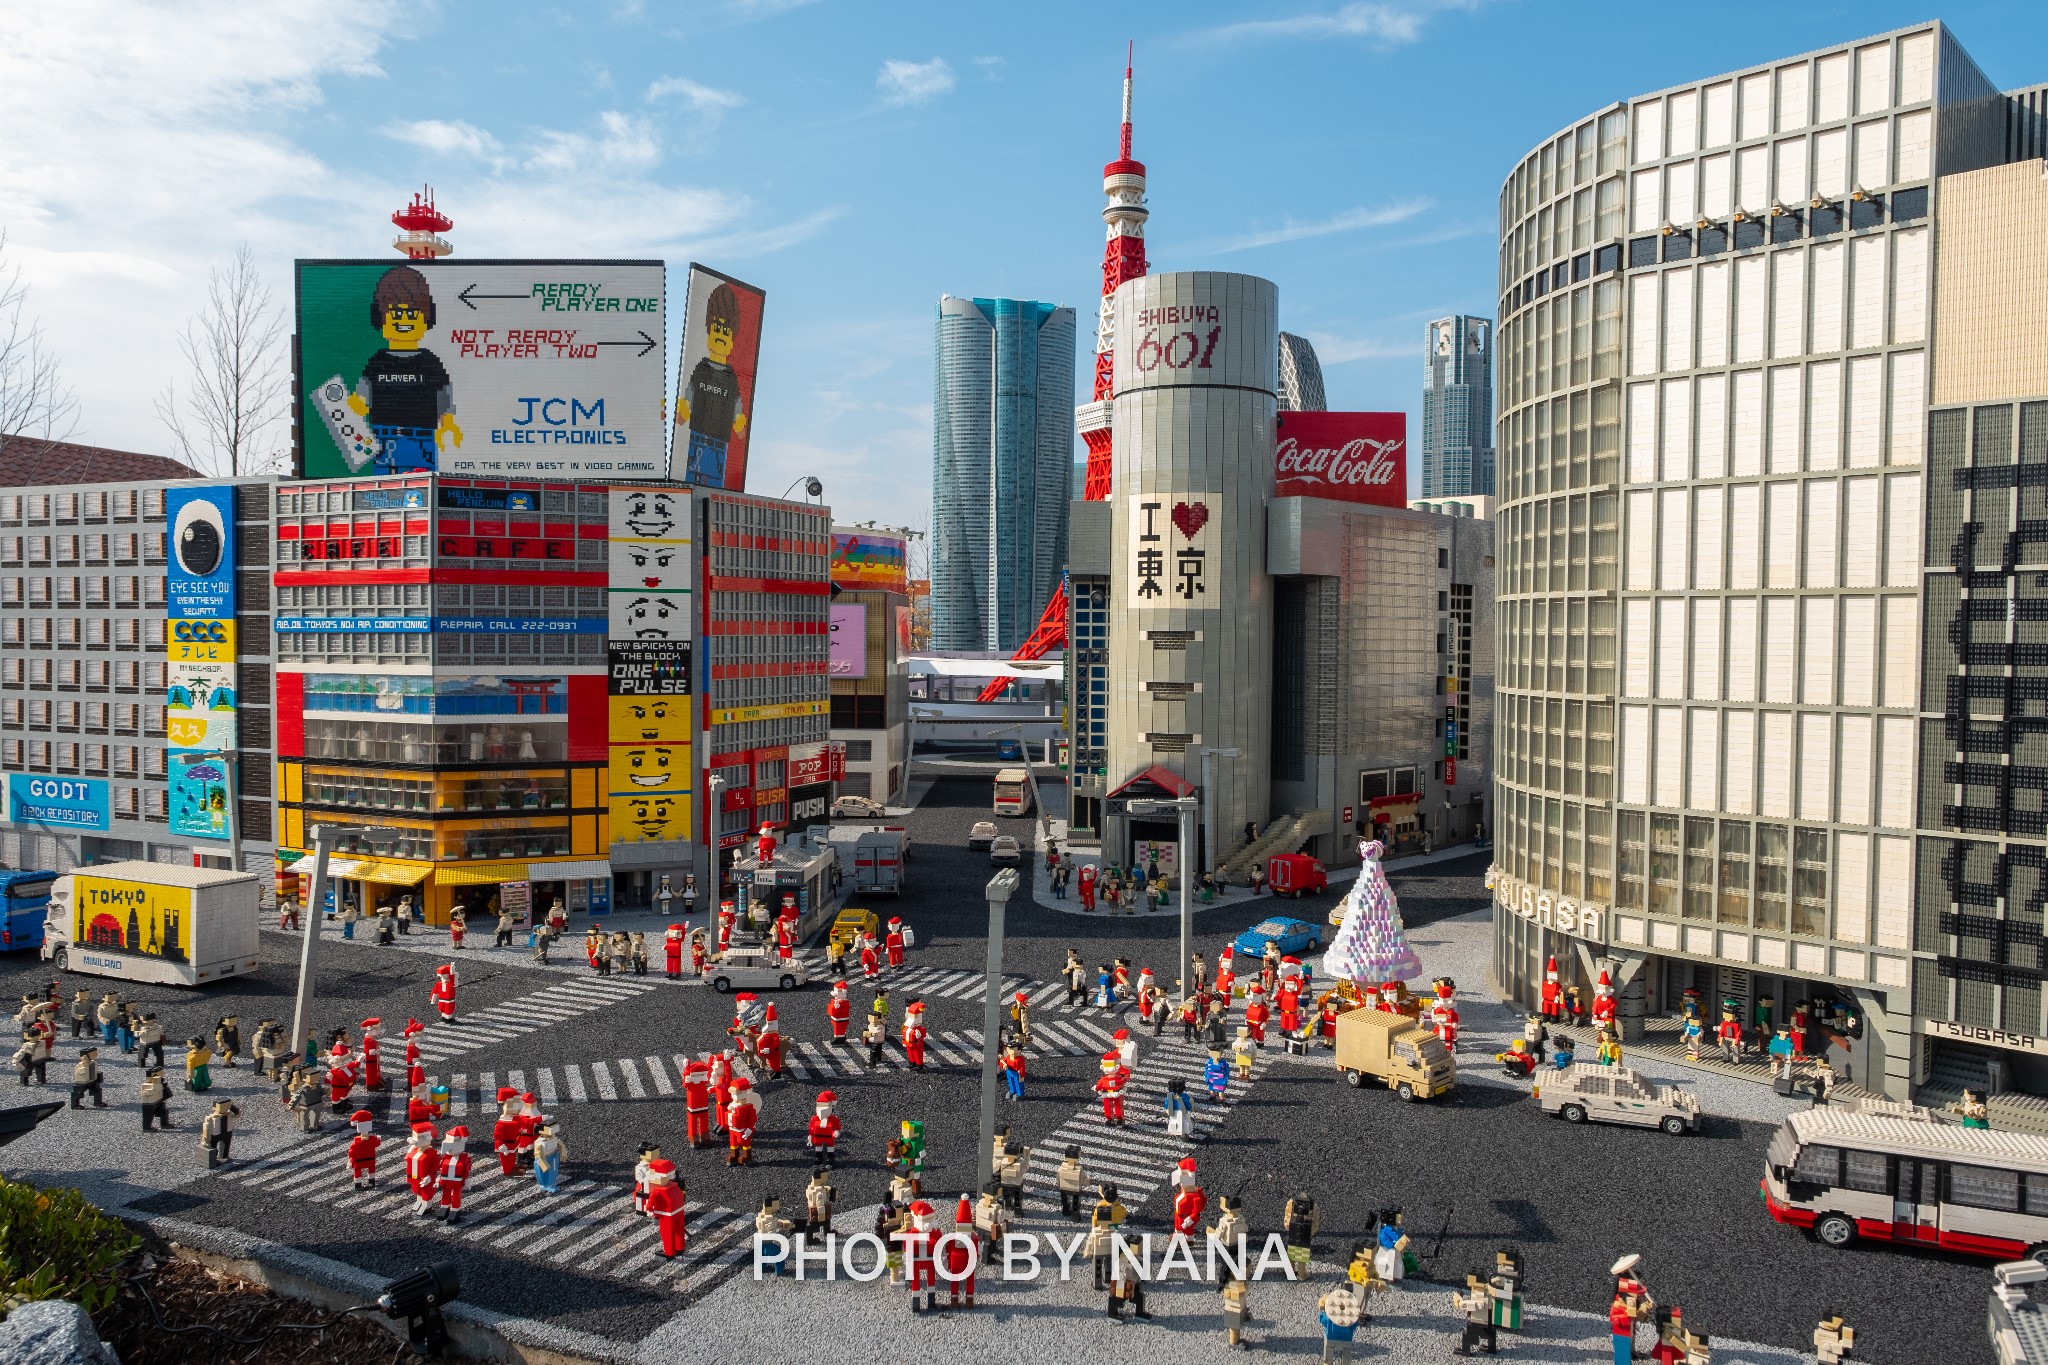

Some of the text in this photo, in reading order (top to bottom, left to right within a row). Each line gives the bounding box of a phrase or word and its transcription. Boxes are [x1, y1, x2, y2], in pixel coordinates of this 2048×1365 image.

[532, 283, 602, 298] READY
[541, 298, 658, 312] PLAYER ONE
[1138, 305, 1219, 327] SHIBUYA
[450, 329, 577, 344] NOT READY
[460, 344, 598, 359] PLAYER TWO
[1136, 326, 1221, 372] 601
[378, 374, 417, 383] PLAYER
[699, 382, 728, 397] PLAYER 2
[511, 397, 605, 427] JCM
[491, 430, 627, 445] ELECTRONICS
[454, 461, 655, 470] FOR THE VERY BEST IN VIDEO GAMING
[365, 491, 388, 501] HELLO
[447, 490, 483, 499] HELLO
[370, 499, 405, 508] PENGUIN
[456, 499, 504, 508] PENGUIN
[302, 540, 392, 560] CAFE
[440, 539, 562, 559] CAFE
[1137, 546, 1206, 600] 東京
[176, 582, 230, 593] EYE SEE YOU
[182, 607, 217, 616] SECURITY
[174, 620, 225, 640] CCC
[276, 620, 289, 629] AIR
[304, 620, 338, 629] TOKYO'S
[357, 620, 371, 629] AIR
[374, 620, 429, 629] CONDITIONING
[440, 621, 577, 630] REPAIR CALL 222-0937
[181, 645, 218, 659] テレビ
[609, 642, 690, 650] NEW BRICKS ON
[620, 652, 681, 660] THE BLOCK
[188, 665, 223, 673] NEIGHBOR
[612, 664, 653, 678] ONE
[620, 679, 687, 694] PULSE
[798, 760, 822, 774] POP
[30, 779, 88, 801] GODT
[756, 788, 786, 806] ELISA
[22, 805, 99, 823] BRICK REPOSITORY
[792, 796, 825, 821] PUSH
[719, 834, 745, 847] GLY FACE
[89, 888, 146, 906] TOKYO
[83, 955, 123, 970] MINILAND
[1930, 1019, 2035, 1049] TSUBASA
